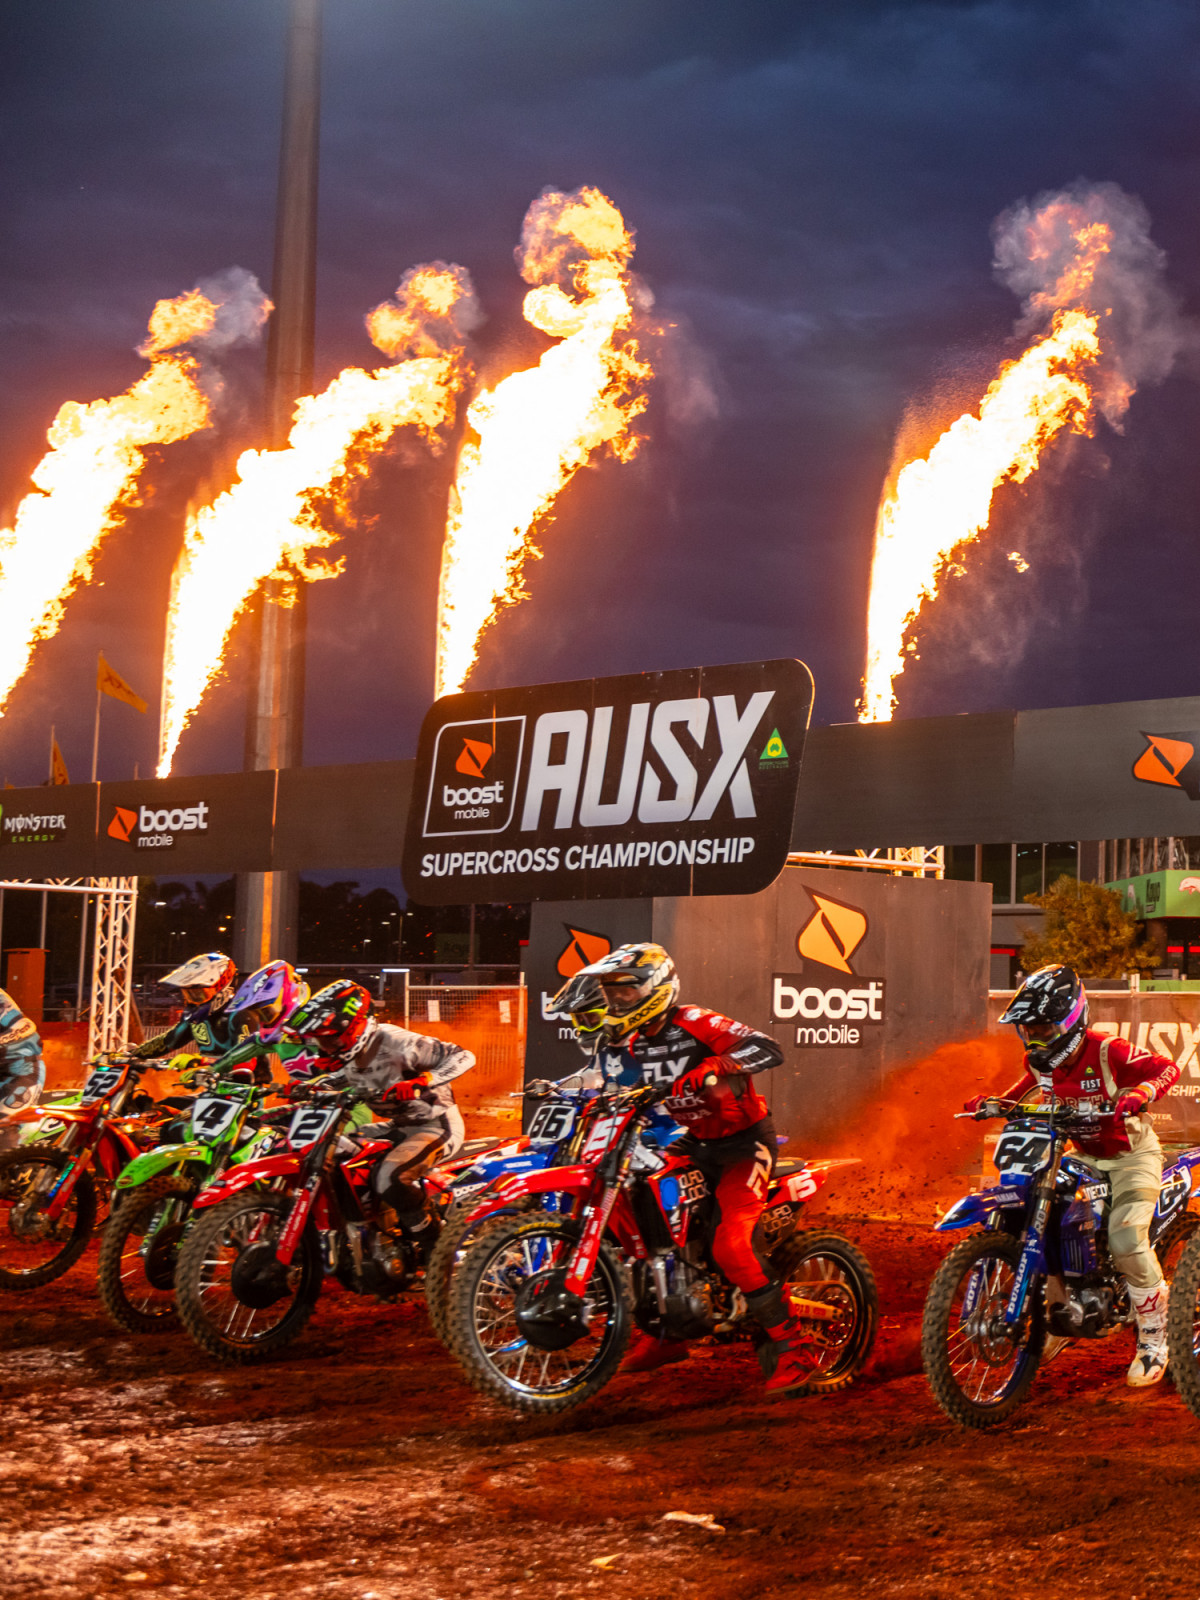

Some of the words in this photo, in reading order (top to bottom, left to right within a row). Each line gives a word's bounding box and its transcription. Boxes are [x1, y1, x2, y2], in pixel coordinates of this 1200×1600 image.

[520, 690, 776, 832] AUSX
[443, 780, 504, 807] boost
[4, 813, 67, 833] MONSTER
[139, 801, 209, 833] boost
[454, 807, 491, 820] mobile
[11, 834, 56, 843] ENERGY
[137, 833, 174, 847] mobile
[420, 846, 561, 878] SUPERCROSS
[564, 837, 756, 870] CHAMPIONSHIP
[773, 978, 883, 1020] boost
[796, 1024, 860, 1044] mobile
[642, 1056, 690, 1084] FLY
[1080, 1078, 1101, 1089] FIST
[84, 1073, 120, 1098] 52
[196, 1100, 233, 1130] 4
[290, 1112, 328, 1141] 2
[530, 1107, 573, 1140] 86
[994, 1135, 1051, 1174] 64
[787, 1171, 818, 1202] 15
[965, 1272, 980, 1312] NLOP
[1007, 1252, 1028, 1315] DUNLOP
